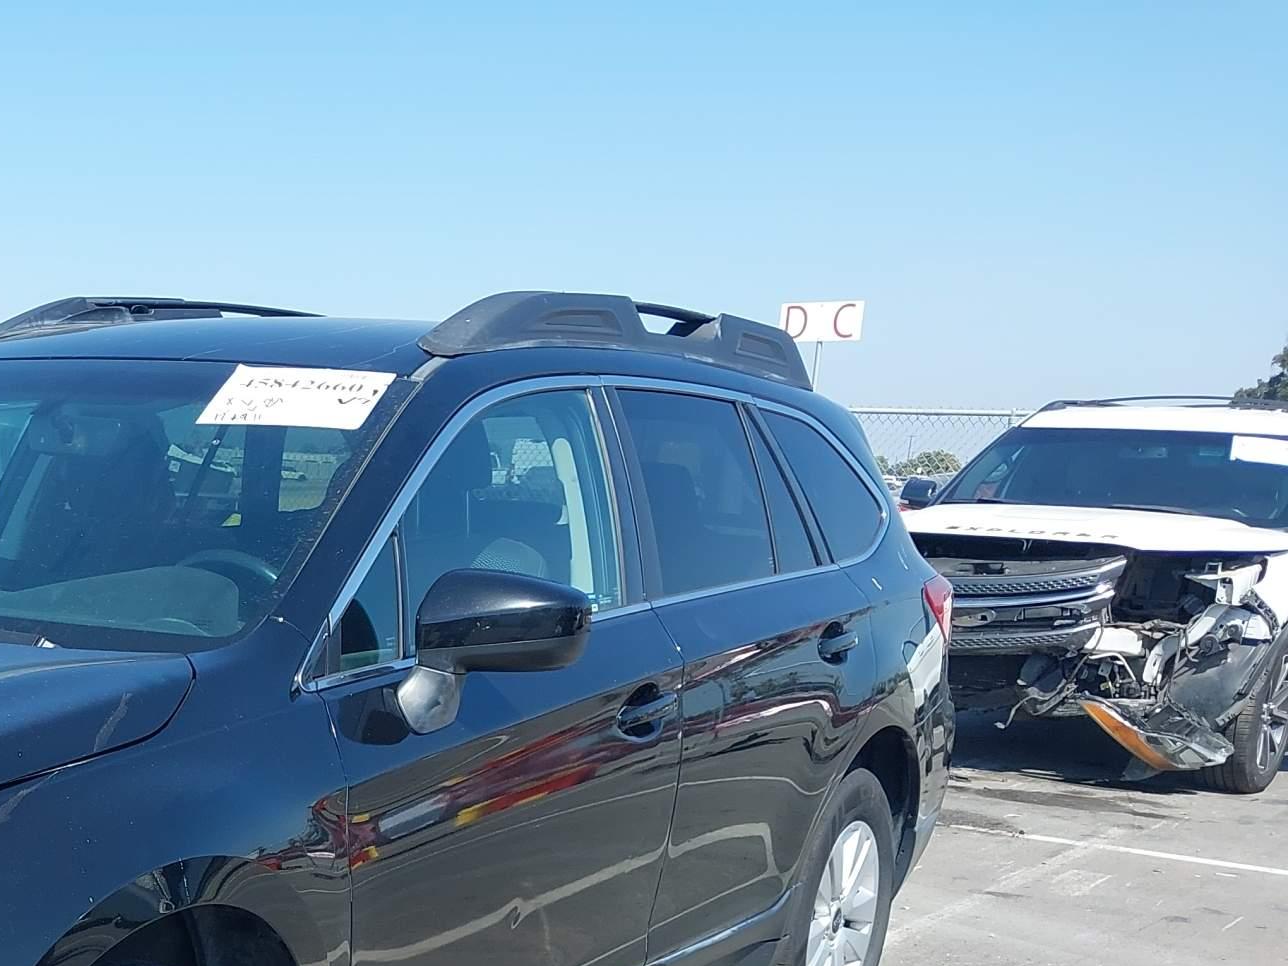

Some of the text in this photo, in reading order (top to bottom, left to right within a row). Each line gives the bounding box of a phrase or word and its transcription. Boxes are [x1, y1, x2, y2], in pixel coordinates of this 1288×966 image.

[785, 303, 856, 339] D C
[945, 525, 1118, 540] EXPLORER
